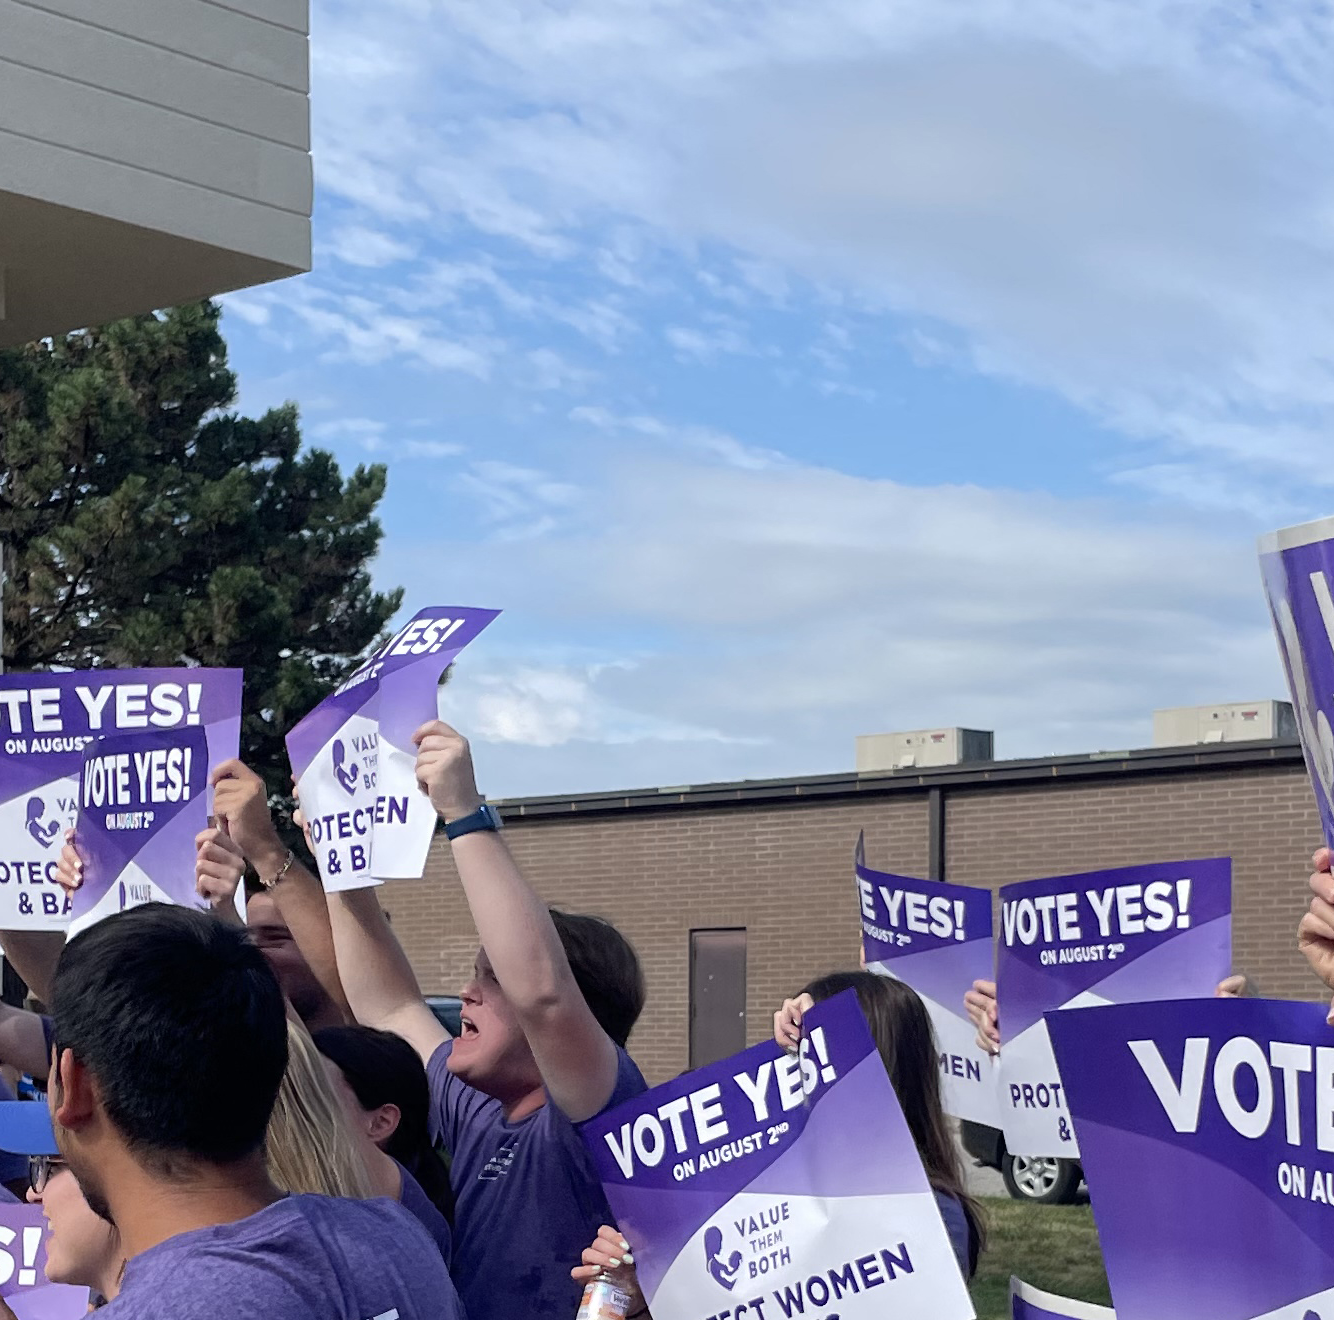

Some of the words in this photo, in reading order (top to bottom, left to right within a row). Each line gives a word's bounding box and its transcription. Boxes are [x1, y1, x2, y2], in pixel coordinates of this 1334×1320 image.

[75, 683, 203, 728] YES!
[5, 739, 27, 755] ON
[84, 754, 130, 807] VOTE
[134, 748, 192, 802] YES!
[308, 806, 374, 843] OTECT
[327, 849, 341, 875] &
[19, 892, 33, 915] &
[878, 885, 965, 941] YES!
[1002, 893, 1081, 947] VOTE
[1086, 879, 1192, 937] YES!
[1040, 949, 1058, 966] ON
[1059, 945, 1105, 964] AUGUST
[603, 1083, 729, 1179] VOTE
[733, 1027, 837, 1122] YES!
[1009, 1082, 1061, 1108] PROT
[1058, 1116, 1072, 1142] &
[673, 1159, 695, 1181] ON
[699, 1133, 765, 1173] AUGUST
[767, 1122, 789, 1145] 2ND
[1277, 1164, 1307, 1198] ON
[734, 1202, 790, 1237] VALUE
[749, 1230, 783, 1254] THEM
[748, 1246, 791, 1279] BOTH
[773, 1242, 915, 1319] WOMEN
